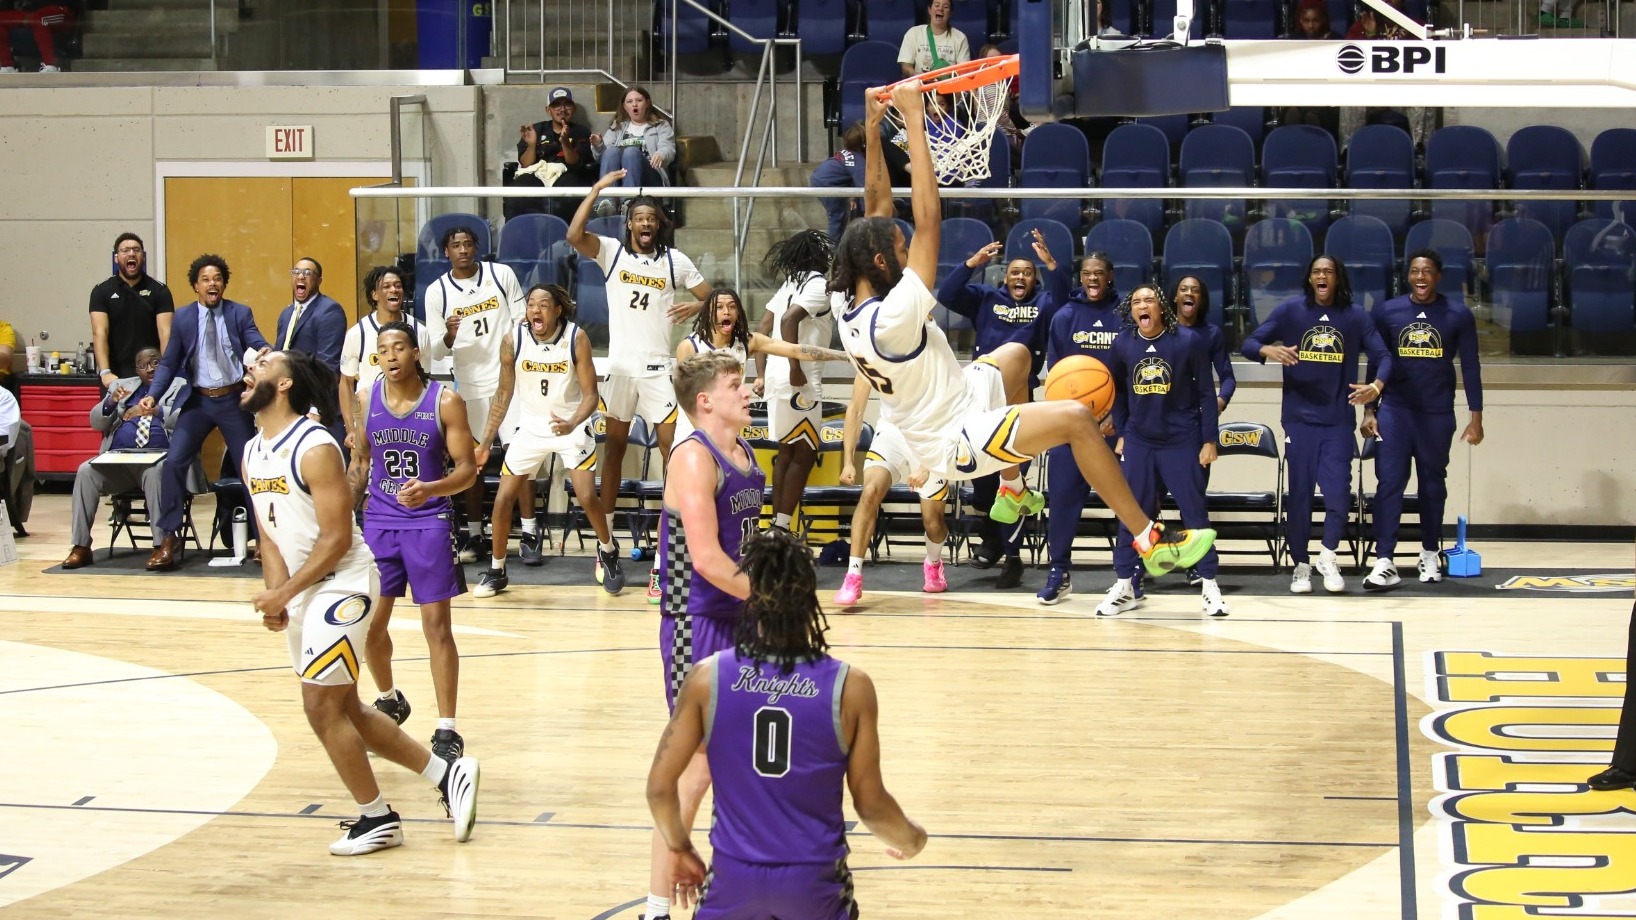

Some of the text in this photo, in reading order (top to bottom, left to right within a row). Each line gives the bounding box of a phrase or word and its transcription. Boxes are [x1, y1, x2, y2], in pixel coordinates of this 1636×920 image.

[1371, 46, 1446, 74] BPI
[274, 128, 305, 153] EXIT
[619, 269, 666, 291] CANES
[453, 296, 499, 319] CANES
[629, 290, 650, 311] 24
[473, 317, 489, 337] 21
[522, 360, 568, 374] CANES
[540, 379, 549, 397] 8
[372, 428, 430, 448] MIDDLE
[1219, 429, 1263, 447] GSW
[384, 450, 420, 479] 23
[250, 475, 290, 495] CANES
[268, 502, 277, 528] 4
[731, 665, 819, 704] Knights
[753, 706, 792, 778] 0
